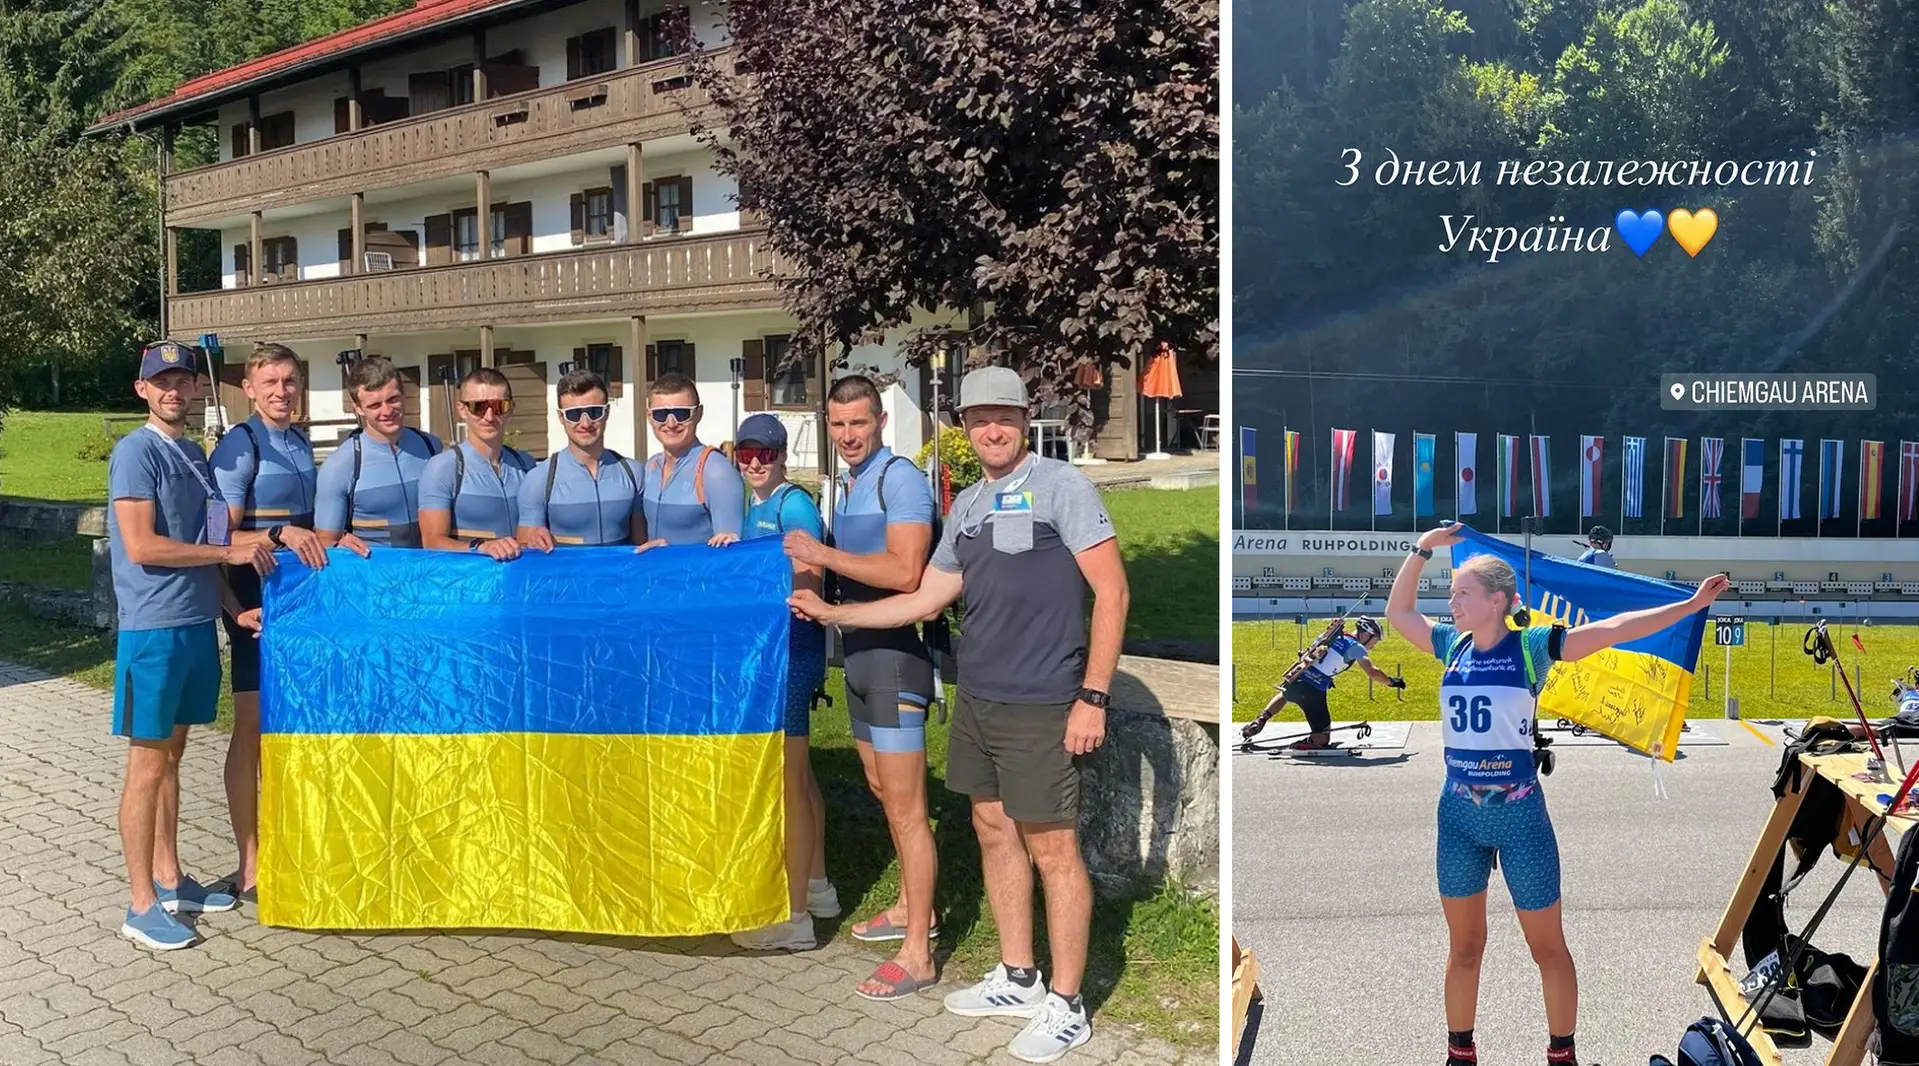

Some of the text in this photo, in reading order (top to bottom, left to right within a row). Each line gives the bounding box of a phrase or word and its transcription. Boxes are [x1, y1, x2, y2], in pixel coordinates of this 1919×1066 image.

[1233, 535, 1411, 552] Arena RUHPOLDING
[1263, 568, 1274, 577] 14
[1324, 568, 1334, 577] 13
[1383, 569, 1393, 577] 12
[1716, 626, 1732, 645] 10
[1734, 627, 1741, 644] 9
[1449, 695, 1492, 733] 36
